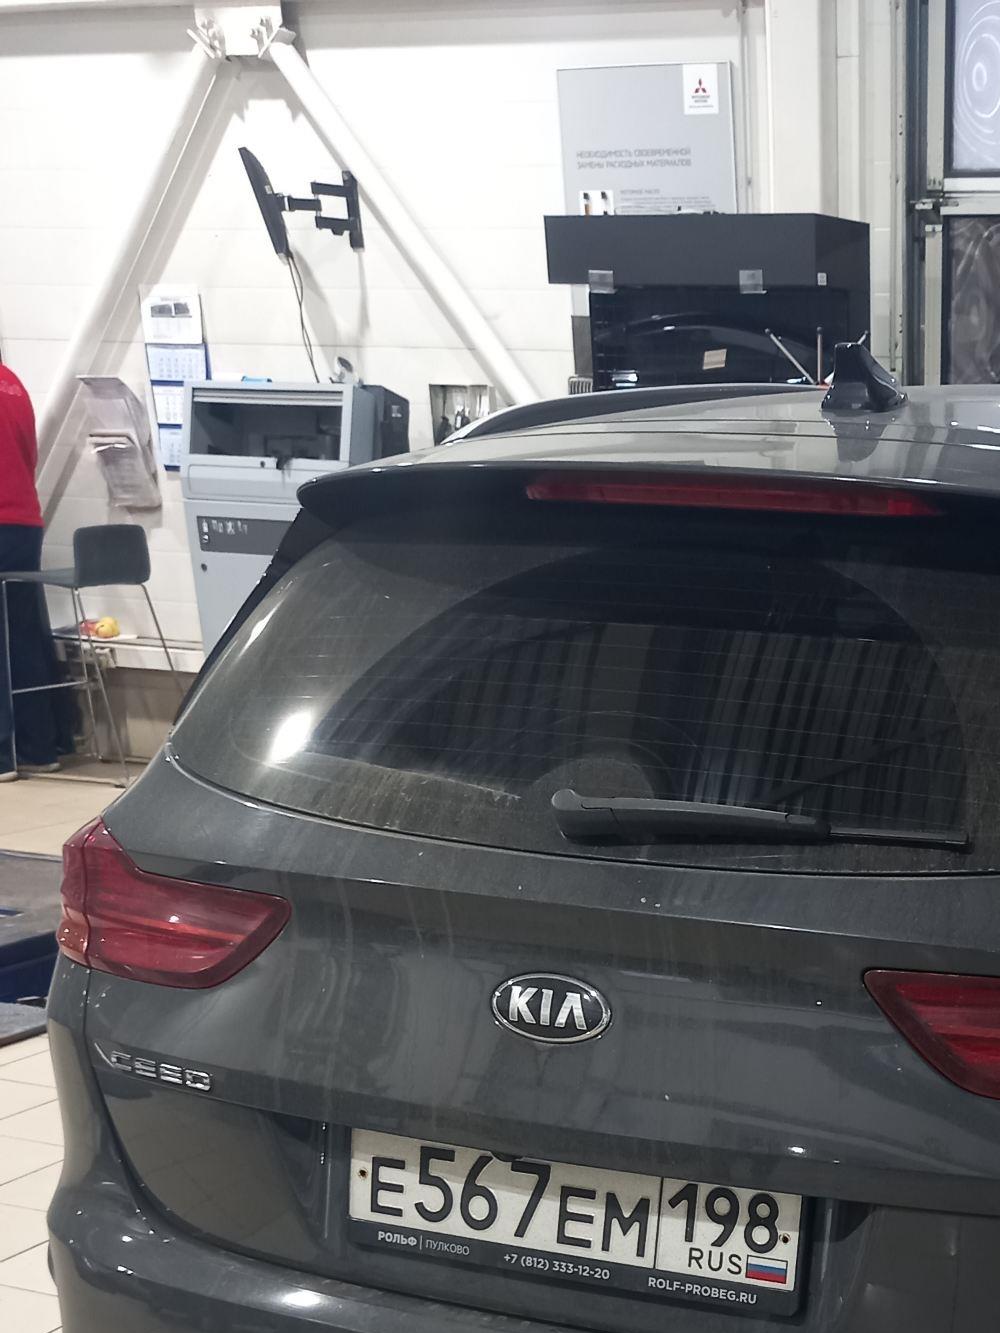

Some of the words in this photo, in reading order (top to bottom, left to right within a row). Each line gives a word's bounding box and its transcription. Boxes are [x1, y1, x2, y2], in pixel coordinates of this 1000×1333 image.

[508, 985, 588, 1031] KIA
[668, 1183, 779, 1254] 198
[378, 1230, 418, 1247] РОЛЬФ
[425, 1238, 470, 1256] ПУЛКОВО
[503, 1253, 518, 1265] +7
[520, 1255, 550, 1271] (812)
[552, 1260, 610, 1281] 333-12-20
[687, 1247, 742, 1275] RUS
[648, 1276, 758, 1305] ROLF-PROBEG.RU
